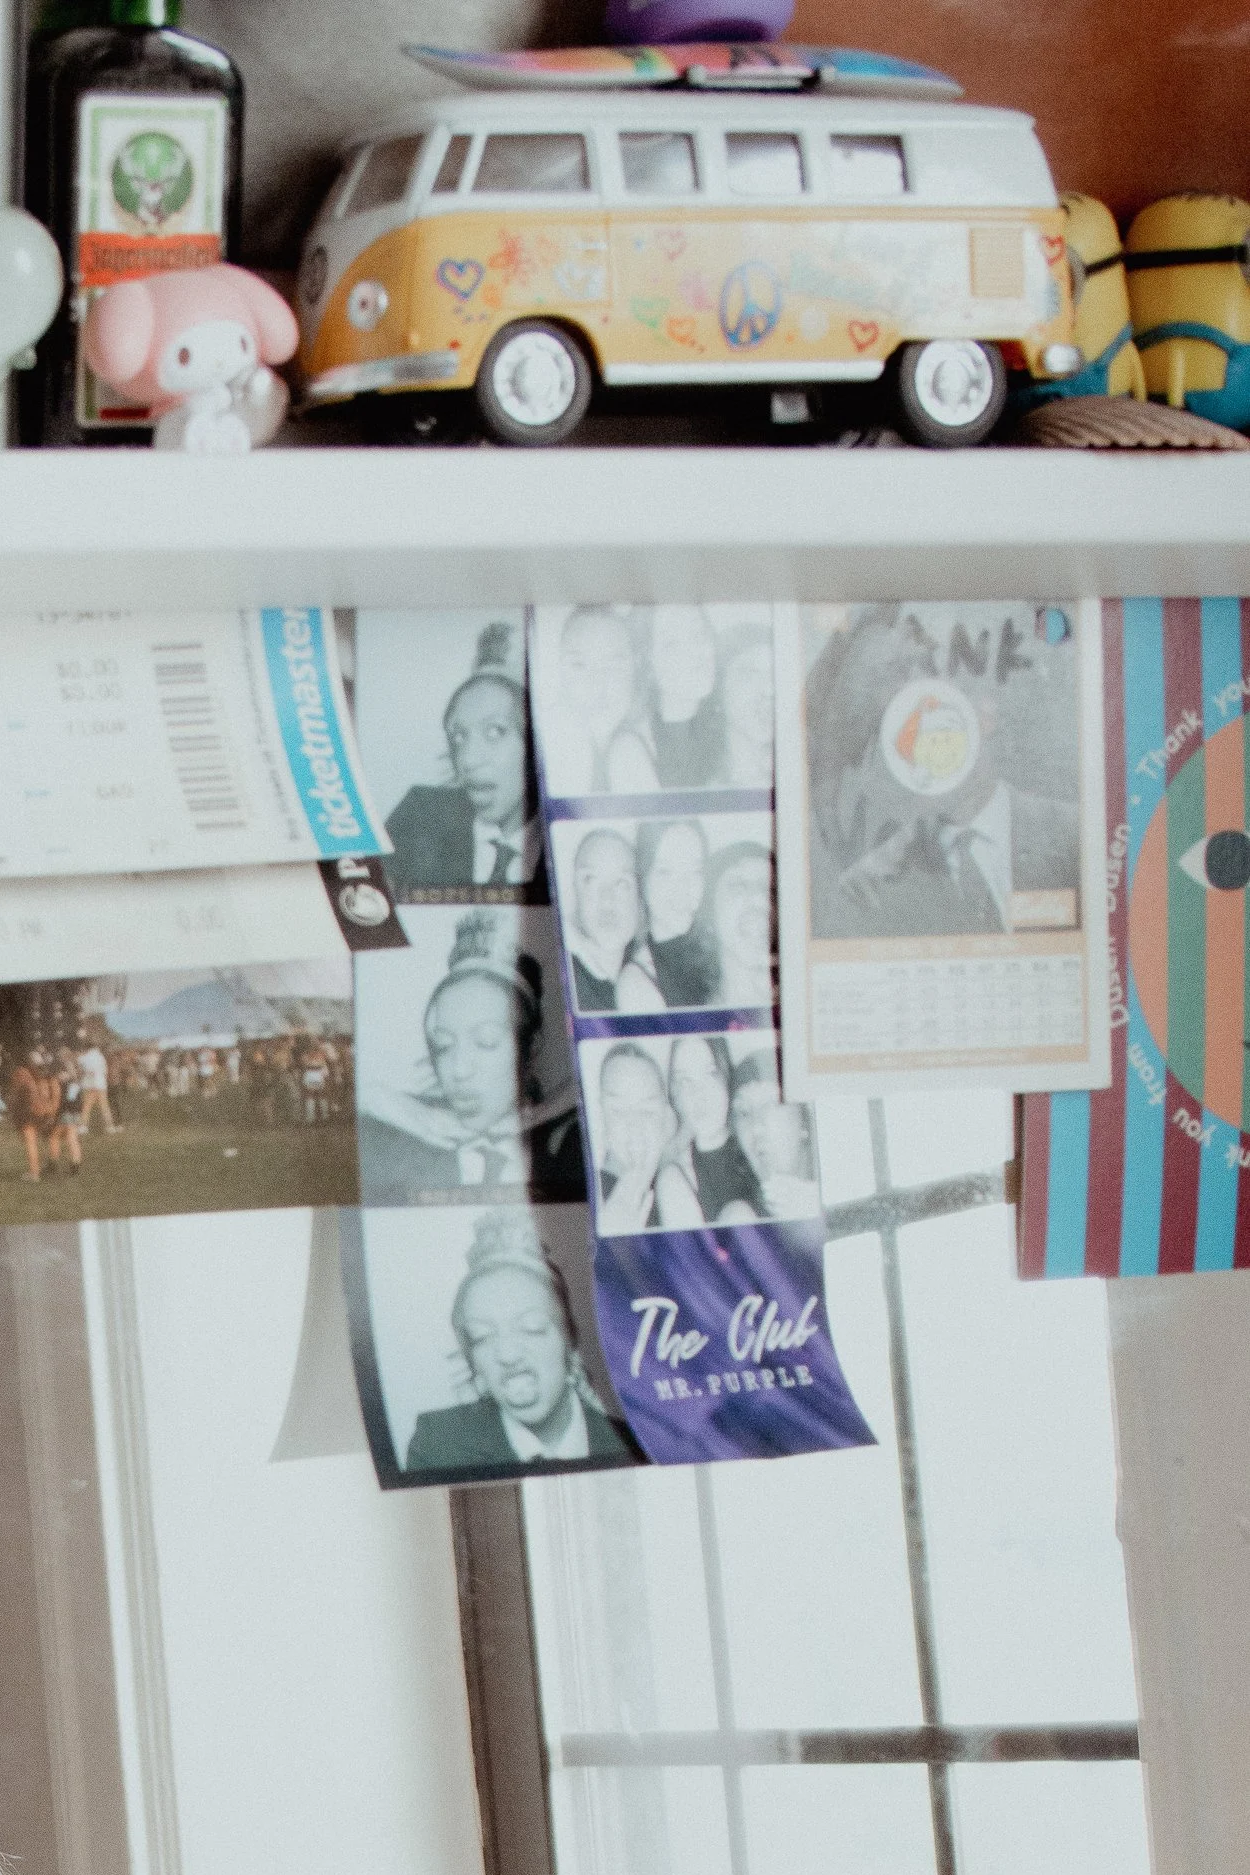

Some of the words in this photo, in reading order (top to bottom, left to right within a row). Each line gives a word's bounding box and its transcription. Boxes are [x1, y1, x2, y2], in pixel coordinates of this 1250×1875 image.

[279, 607, 362, 841] ticketmaster
[1135, 708, 1200, 781] Thank
[1127, 1042, 1167, 1105] from
[630, 1296, 710, 1379] The
[727, 1294, 819, 1365] Club
